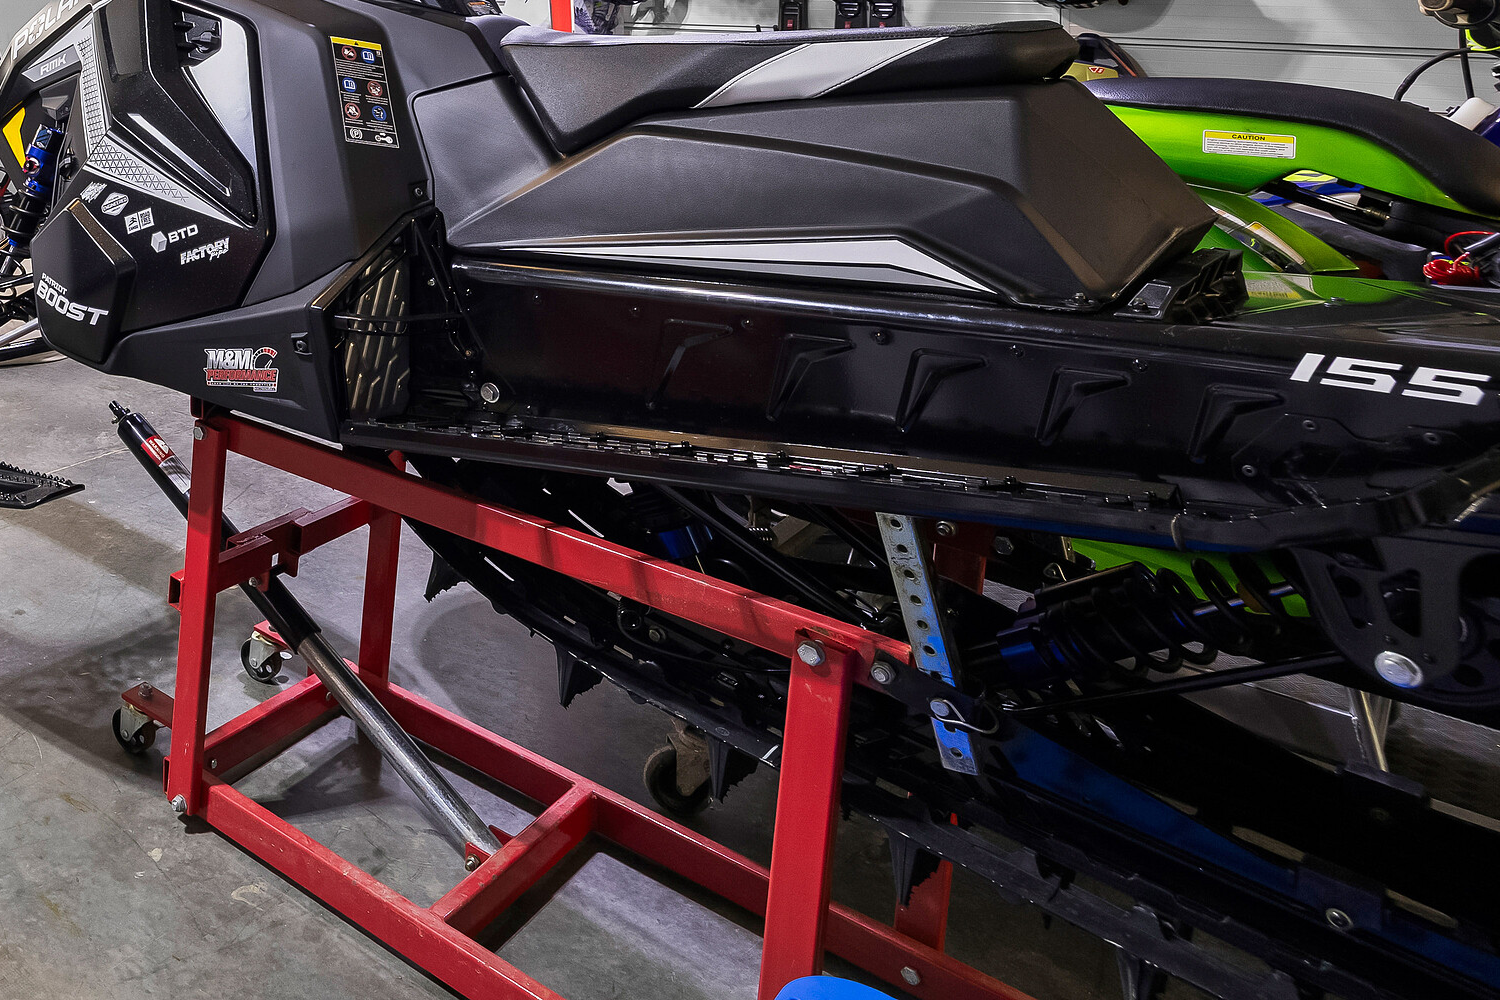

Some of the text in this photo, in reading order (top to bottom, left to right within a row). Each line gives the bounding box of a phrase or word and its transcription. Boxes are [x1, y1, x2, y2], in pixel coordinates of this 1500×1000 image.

[40, 53, 67, 76] RMK
[168, 224, 199, 243] BTD
[180, 237, 230, 265] FACTORY
[41, 272, 67, 295] PATRIOT
[36, 280, 109, 326] BOOST
[206, 349, 253, 370] M&M
[206, 369, 277, 382] PERFORMANCE
[1289, 352, 1492, 406] 155
